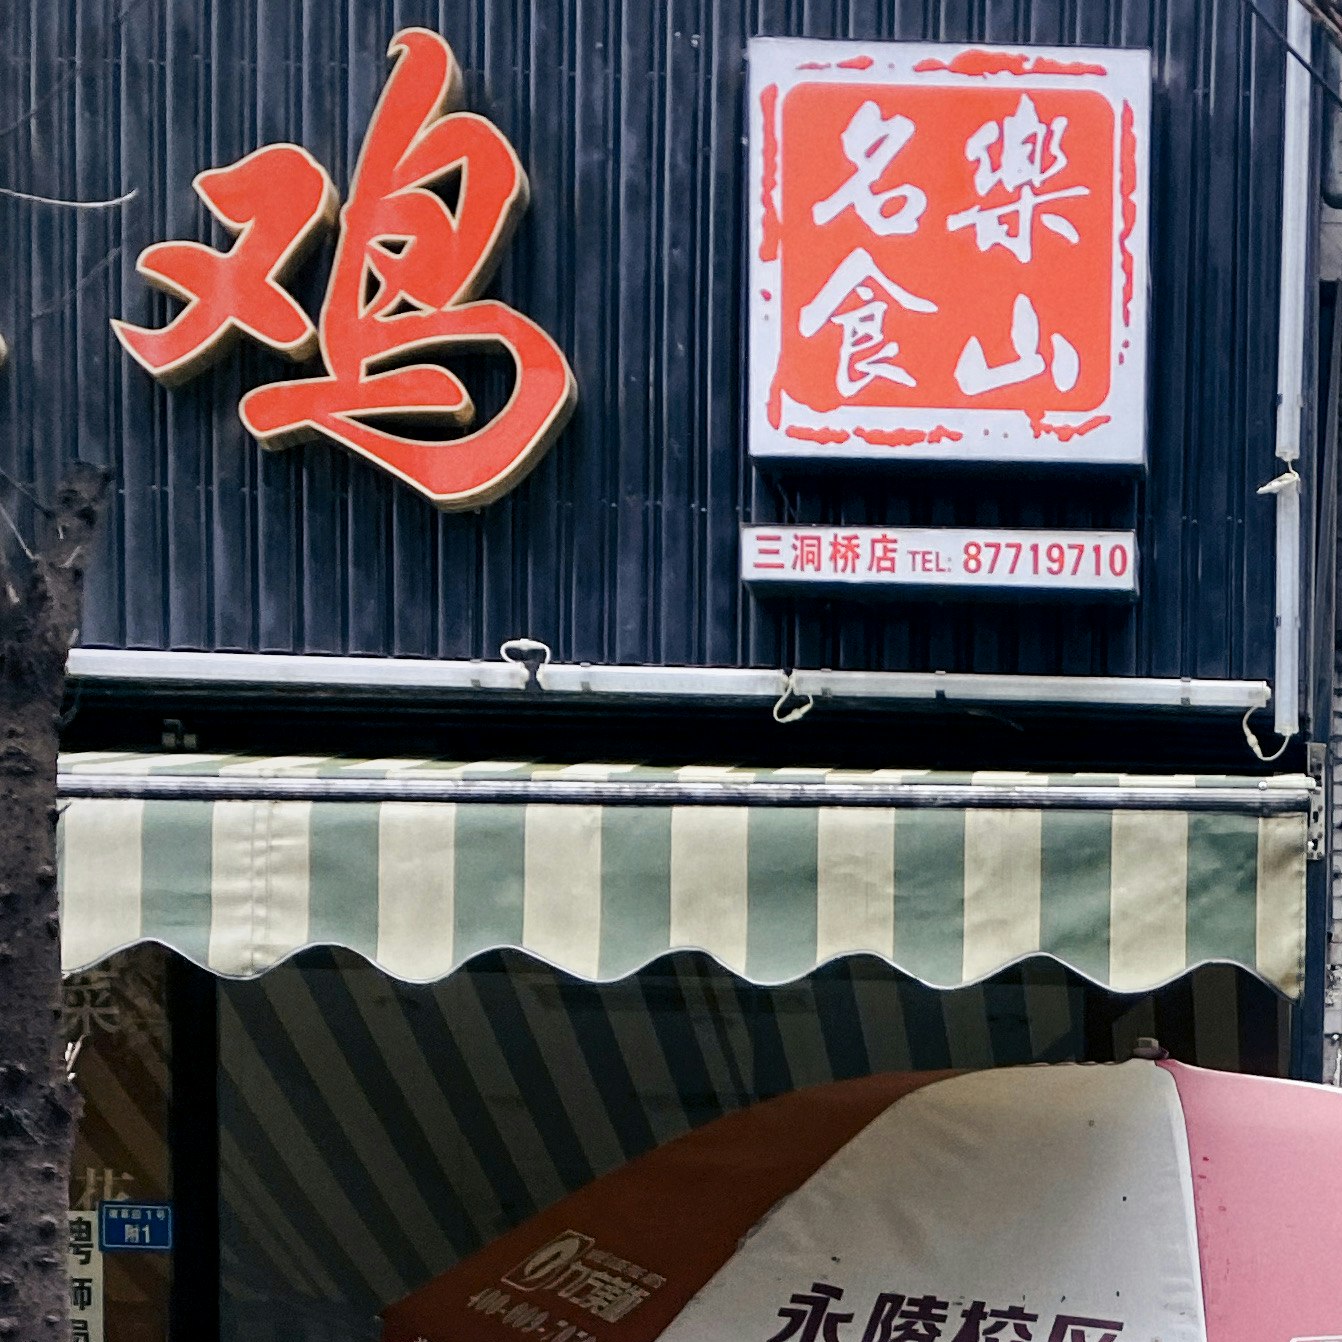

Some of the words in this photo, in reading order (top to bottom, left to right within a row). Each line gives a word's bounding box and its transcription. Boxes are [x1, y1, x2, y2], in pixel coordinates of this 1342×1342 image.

[111, 26, 578, 512] 鸡
[798, 99, 939, 398] 名食
[946, 92, 1091, 397] 樂山
[752, 532, 899, 574] 三洞桥店
[907, 549, 953, 573] TEL:
[962, 540, 1129, 577] 87719710
